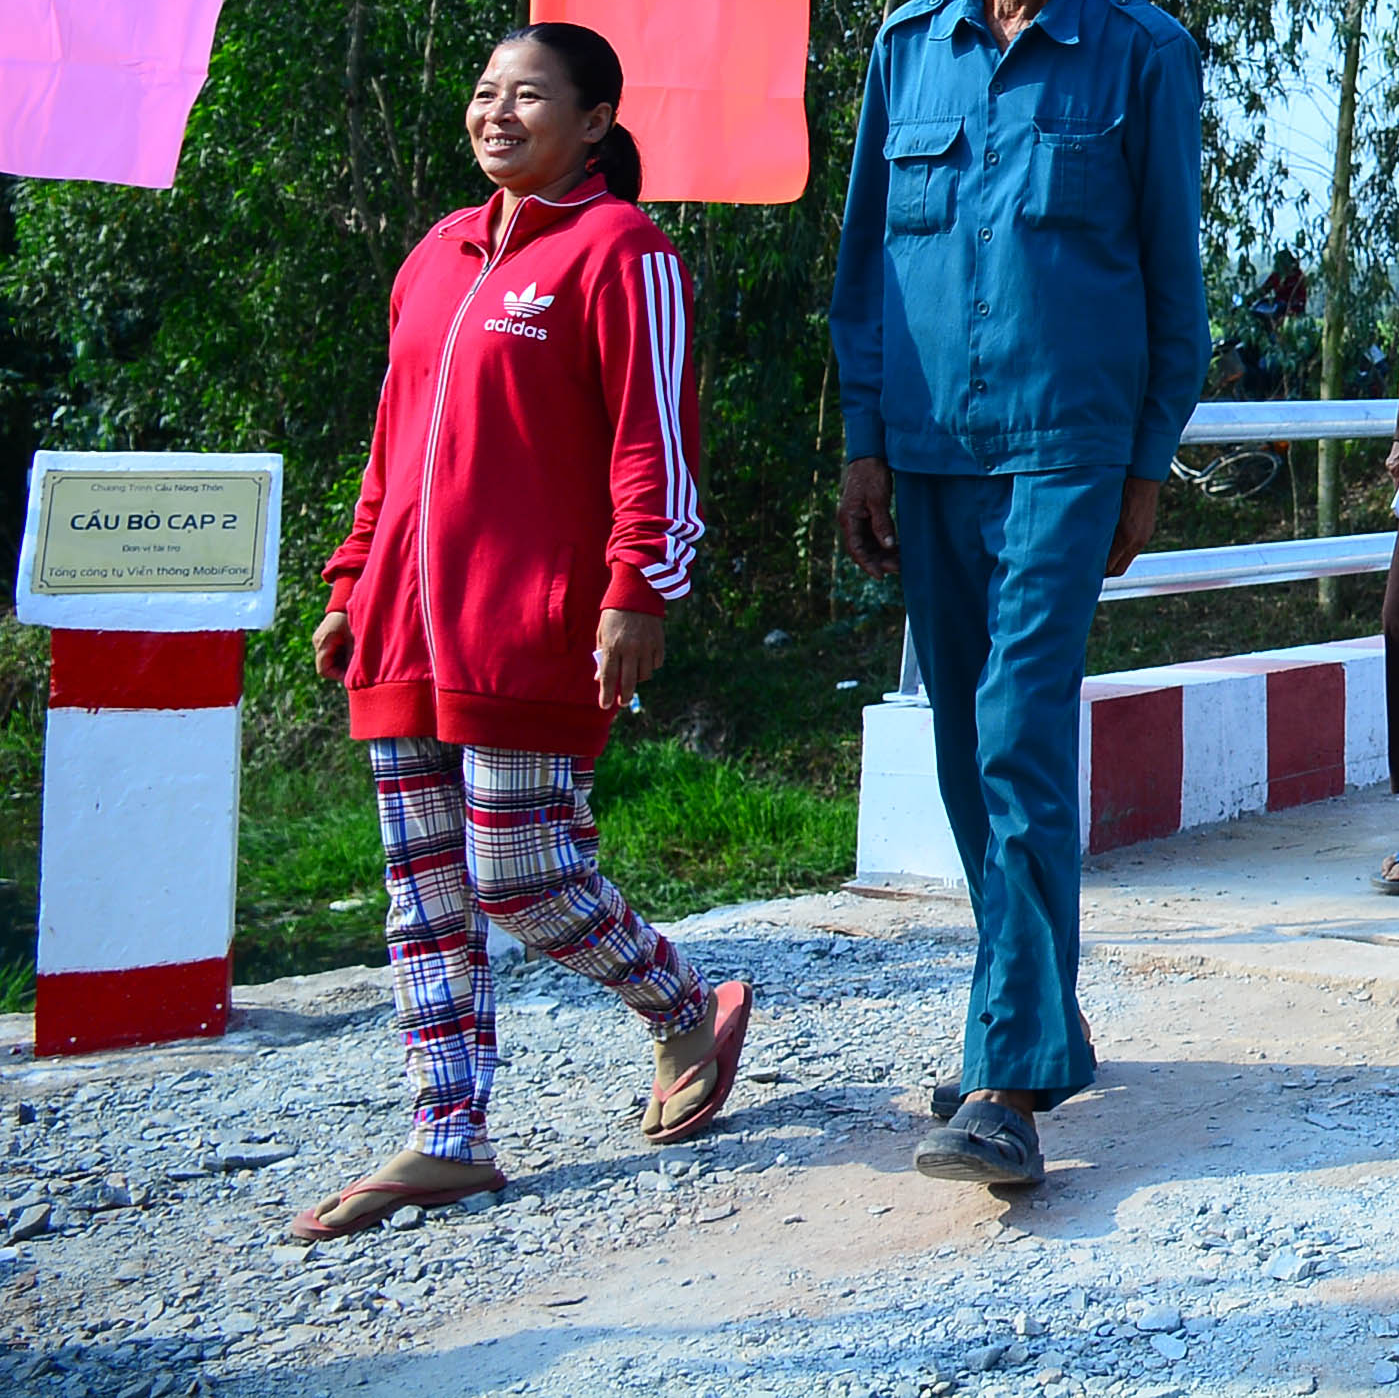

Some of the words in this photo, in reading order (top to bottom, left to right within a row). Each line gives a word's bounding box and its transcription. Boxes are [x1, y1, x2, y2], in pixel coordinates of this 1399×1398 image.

[484, 317, 548, 341] adidas
[167, 514, 216, 534] CẠP
[221, 514, 238, 530] 2
[111, 567, 124, 578] ty
